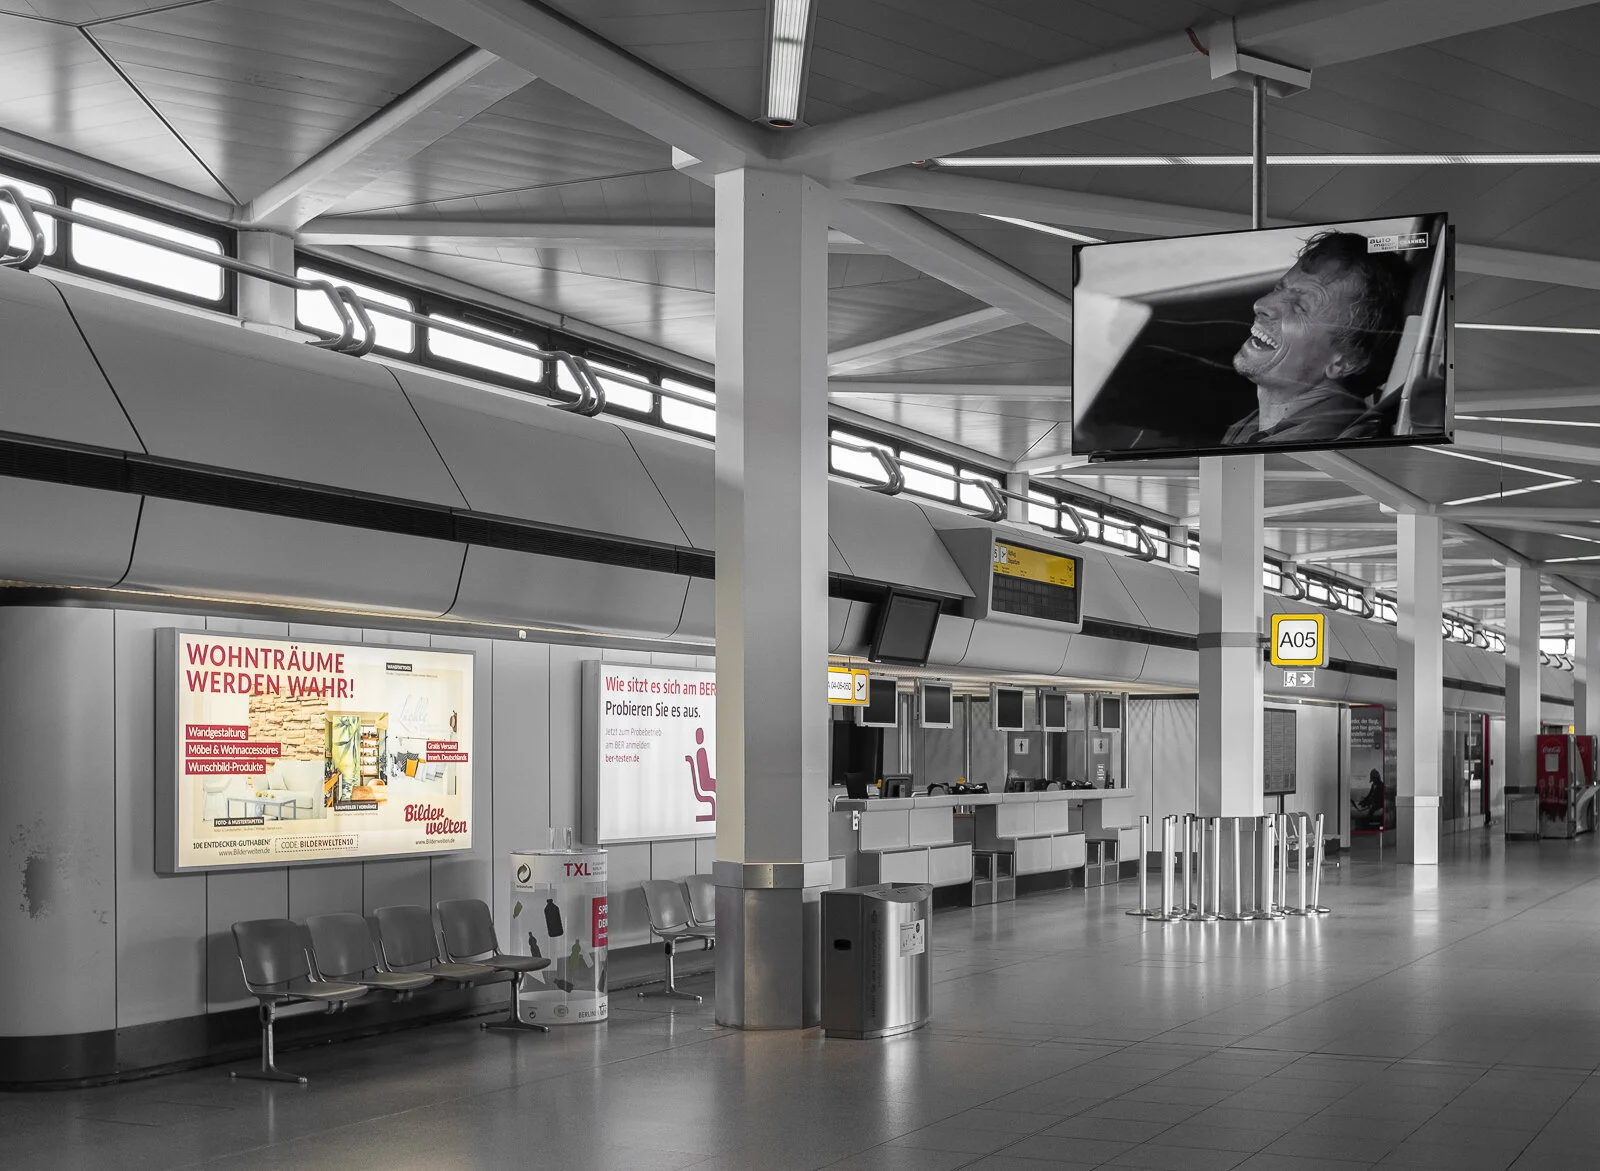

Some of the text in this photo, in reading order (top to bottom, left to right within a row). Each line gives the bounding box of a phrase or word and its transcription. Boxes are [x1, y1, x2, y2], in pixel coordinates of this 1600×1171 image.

[1280, 632, 1316, 648] A05
[186, 643, 344, 674] WOHNTRÄUME
[186, 670, 354, 698] WERDEN WAHR!
[605, 676, 716, 696] Wie sitzt es sich am BER
[605, 700, 701, 718] Probieren Sie es aus.
[188, 727, 246, 739] Wandgestaltung
[188, 744, 278, 755] Möbel & Wohnaccessoires
[605, 754, 640, 763] ber-testen.de
[188, 762, 264, 772] Wunschbild-Produkte
[404, 804, 444, 822] Bilder
[425, 818, 467, 835] welten
[300, 839, 354, 848] BILDERWELTEN10
[563, 863, 591, 877] TXL
